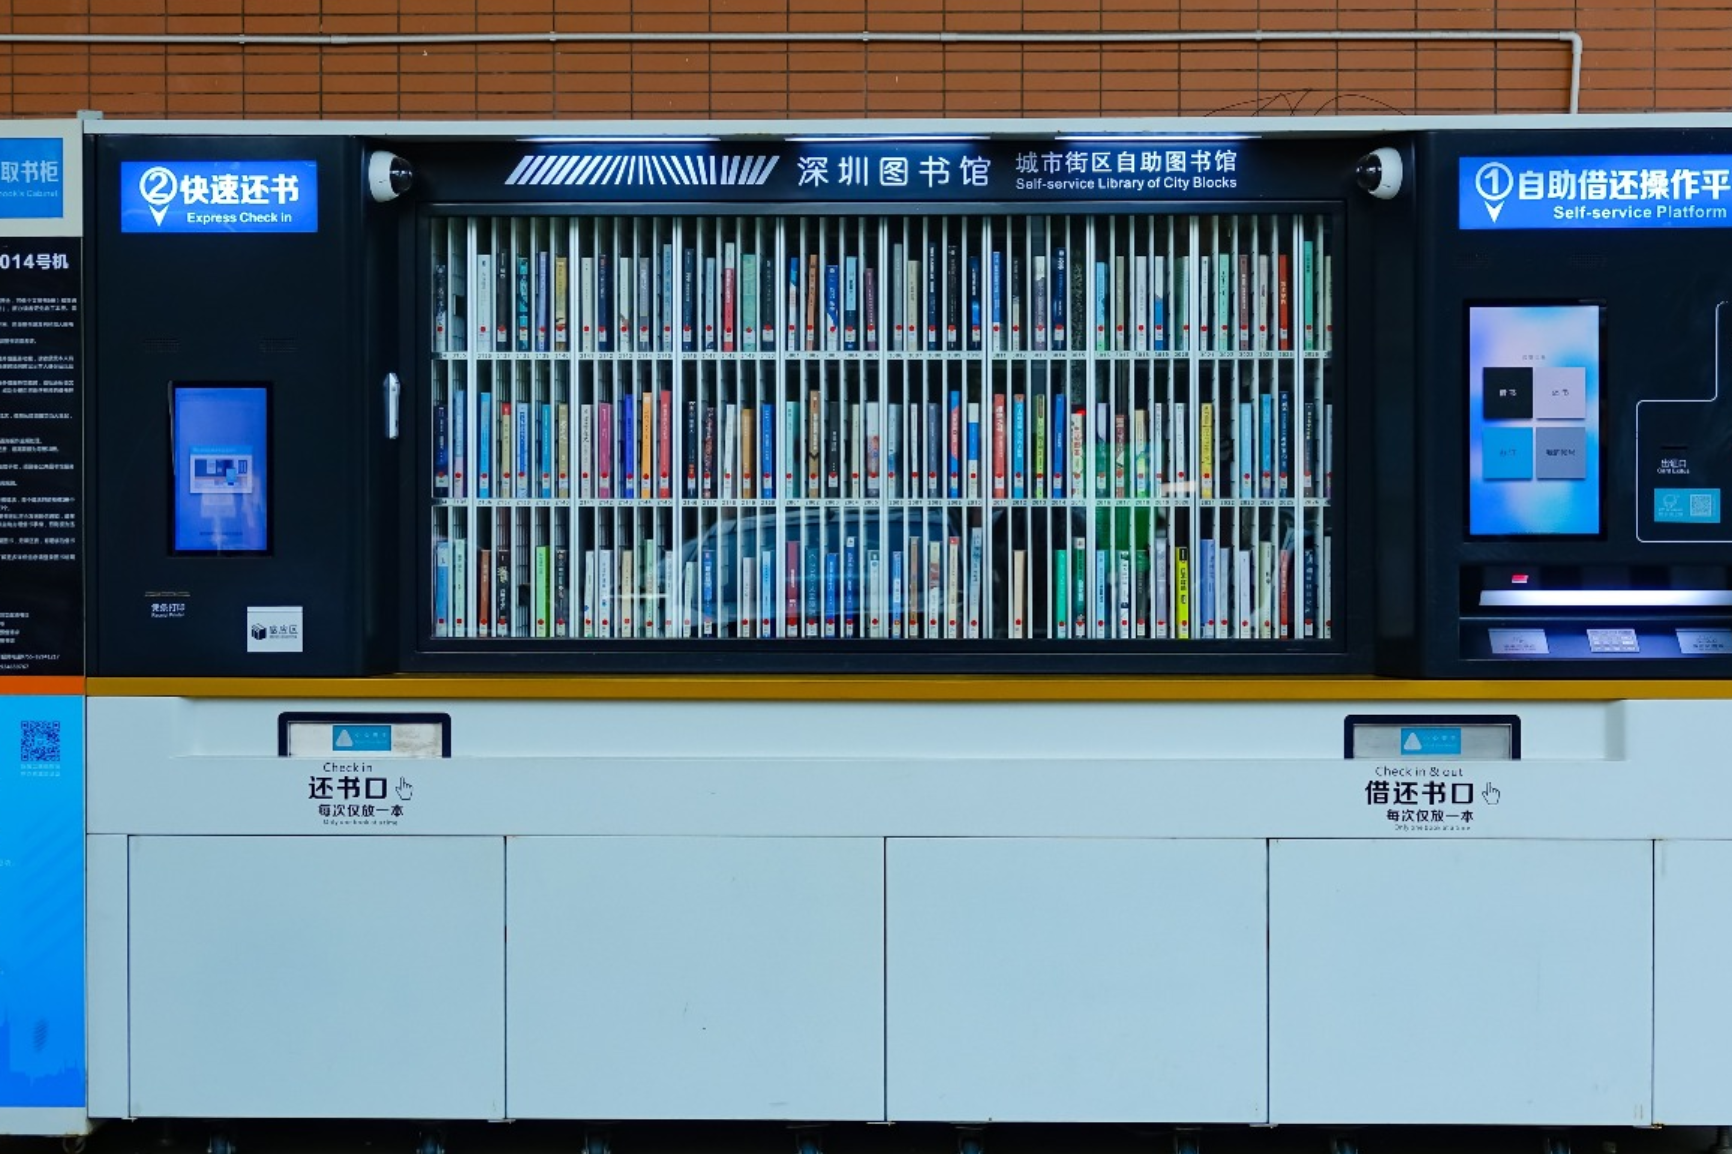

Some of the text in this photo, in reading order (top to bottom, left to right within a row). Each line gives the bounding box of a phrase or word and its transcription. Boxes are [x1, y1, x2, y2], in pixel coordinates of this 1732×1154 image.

[1015, 150, 1237, 174] 城市街区自助图书馆
[1, 160, 59, 183] 取书柜
[797, 156, 991, 187] 深圳图书馆
[180, 174, 299, 205] 快速还书
[1015, 177, 1237, 191] Self-service Library of City Blocks
[187, 211, 292, 225] Express Check in
[1553, 204, 1727, 220] Self-service Platform
[323, 762, 372, 773] Check in
[1375, 766, 1464, 777] Check in & out
[308, 775, 388, 800] 还书口
[1364, 780, 1474, 805] 借还书口
[318, 804, 404, 818] 每次仅放一本
[1386, 809, 1474, 823] 每次仅放一本
